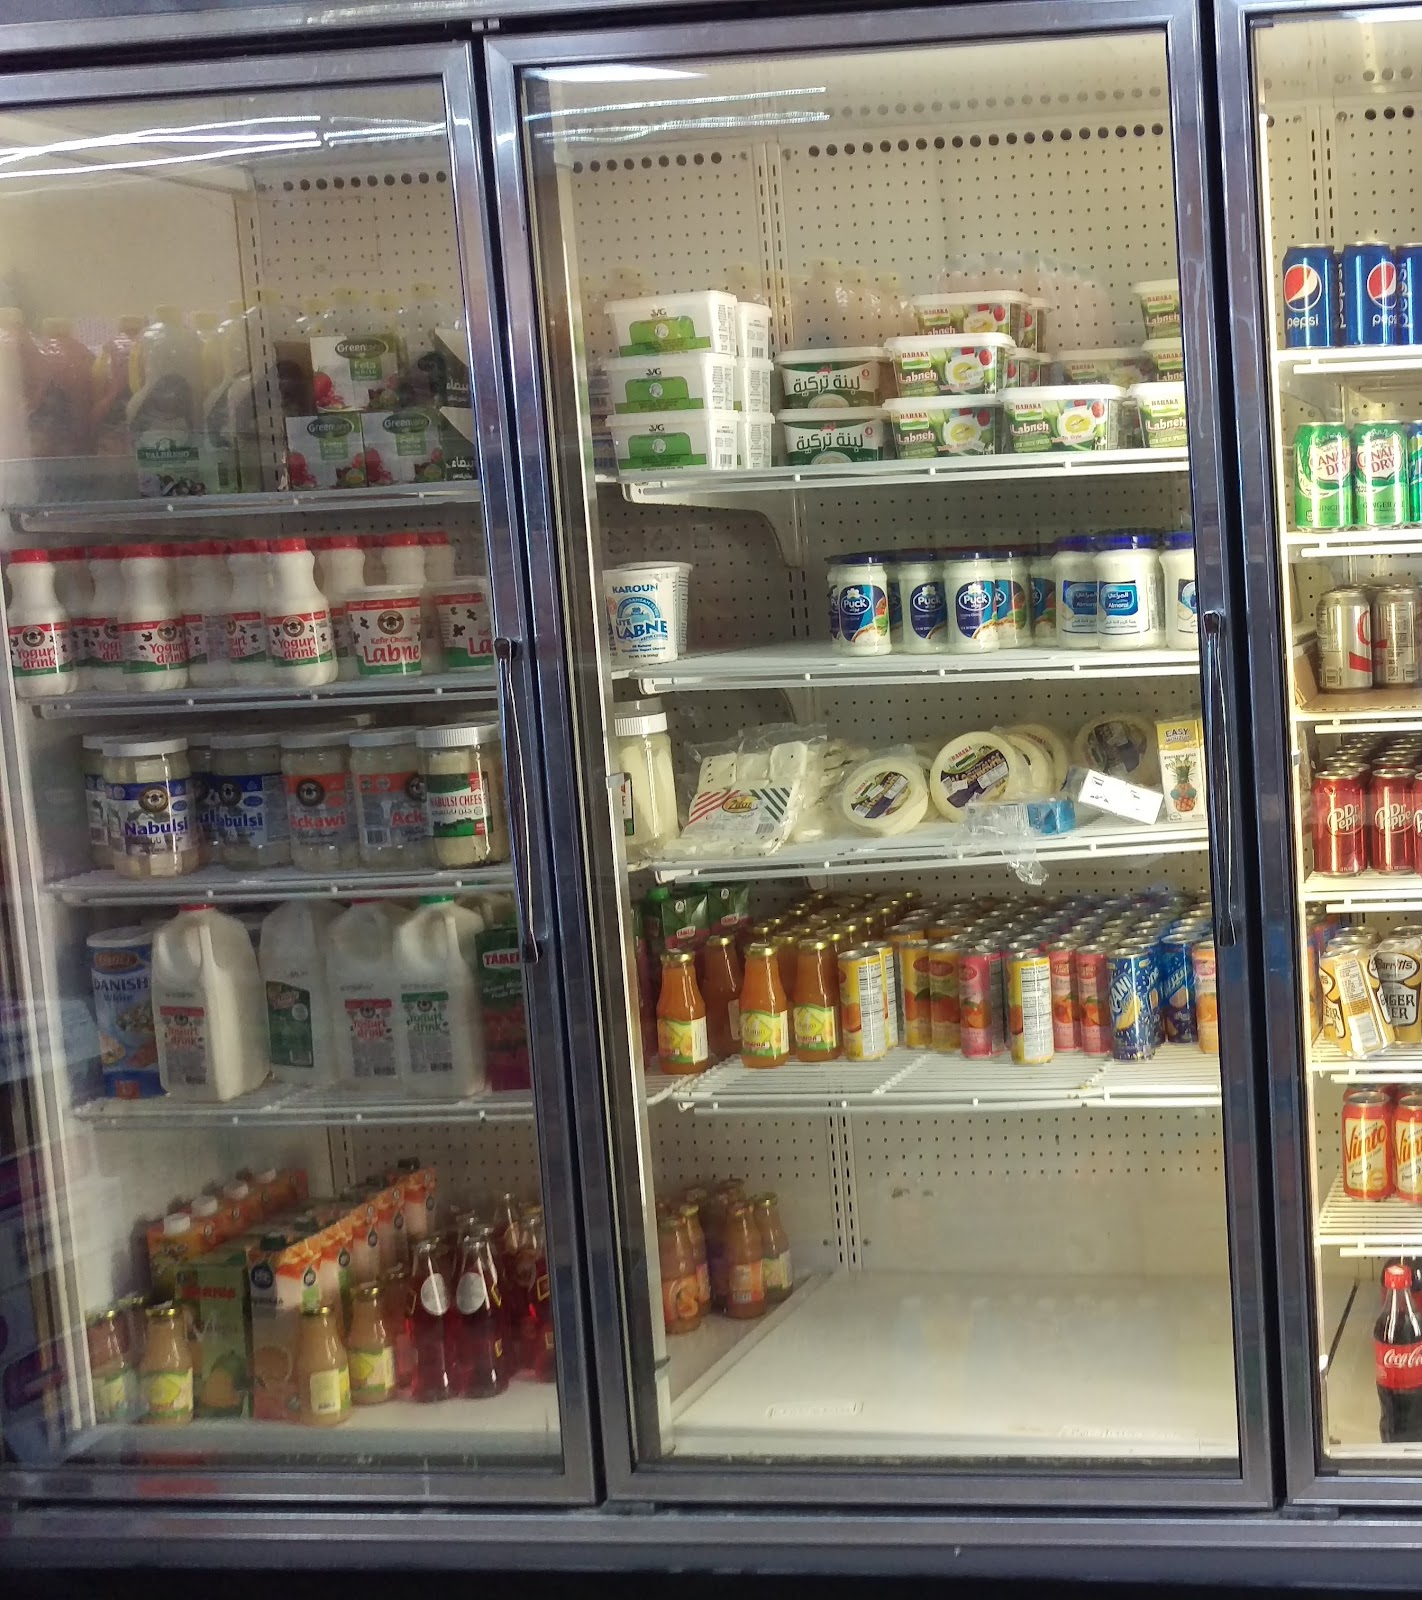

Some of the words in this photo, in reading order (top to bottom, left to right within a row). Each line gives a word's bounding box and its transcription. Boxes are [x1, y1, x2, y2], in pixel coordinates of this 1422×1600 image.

[1287, 313, 1319, 329] pepsi
[1372, 313, 1397, 327] peps
[902, 351, 929, 359] BARAKA
[899, 370, 938, 383] Labneh
[1156, 372, 1184, 382] Labne
[793, 374, 829, 397] تركية
[833, 374, 860, 395] لبنة
[1015, 402, 1043, 410] BARAKA
[900, 412, 928, 420] BARAKA
[1010, 421, 1050, 434] Labneh
[1147, 417, 1187, 431] Labneh
[796, 432, 832, 454] تركية
[836, 432, 864, 453] لبنة
[898, 431, 935, 444] Labneh
[1371, 460, 1396, 474] DRY
[612, 583, 658, 594] KAROUN
[843, 599, 866, 608] Puck
[918, 597, 942, 606] Puck
[964, 595, 988, 605] Puck
[1108, 601, 1129, 609] Almarai
[616, 620, 668, 640] LABNE
[278, 638, 317, 651] Yogurt
[17, 648, 58, 662] Yogurt
[156, 652, 186, 665] drink
[284, 648, 317, 660] drink
[363, 644, 420, 664] Labne
[22, 657, 57, 670] drink
[1165, 728, 1189, 738] EASY
[1344, 804, 1359, 817] Dr
[1389, 803, 1407, 817] Dr
[216, 812, 263, 829] abulsi
[391, 810, 425, 826] Ack
[1328, 808, 1360, 832] Pepp
[1375, 807, 1412, 831] Peppe
[124, 816, 189, 837] Nabulsi
[485, 952, 520, 966] TAME
[93, 977, 150, 992] DANISH
